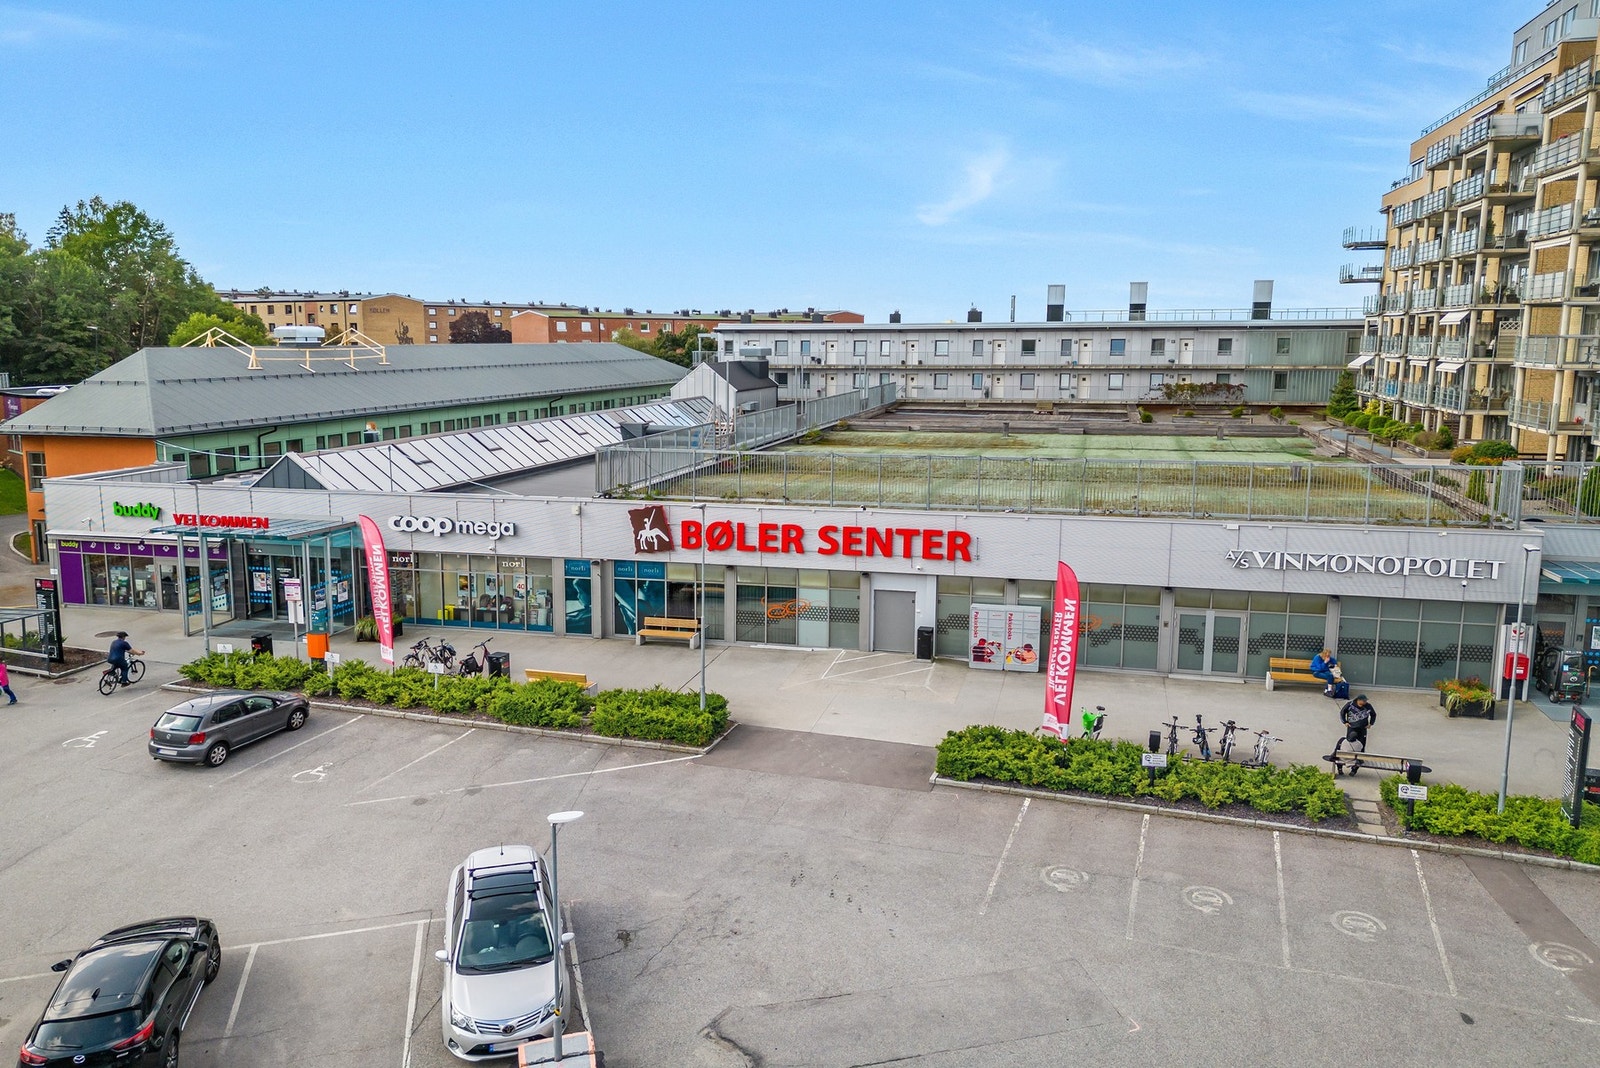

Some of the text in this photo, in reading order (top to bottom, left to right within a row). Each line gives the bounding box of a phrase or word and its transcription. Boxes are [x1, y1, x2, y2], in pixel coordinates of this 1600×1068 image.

[113, 501, 160, 520] buddy
[172, 513, 269, 529] VELKOMMEN
[387, 515, 516, 540] coop mega
[60, 540, 79, 549] buddy
[681, 519, 972, 562] BØLER SENTER
[1224, 550, 1505, 580] A/S VINMONOPOLET
